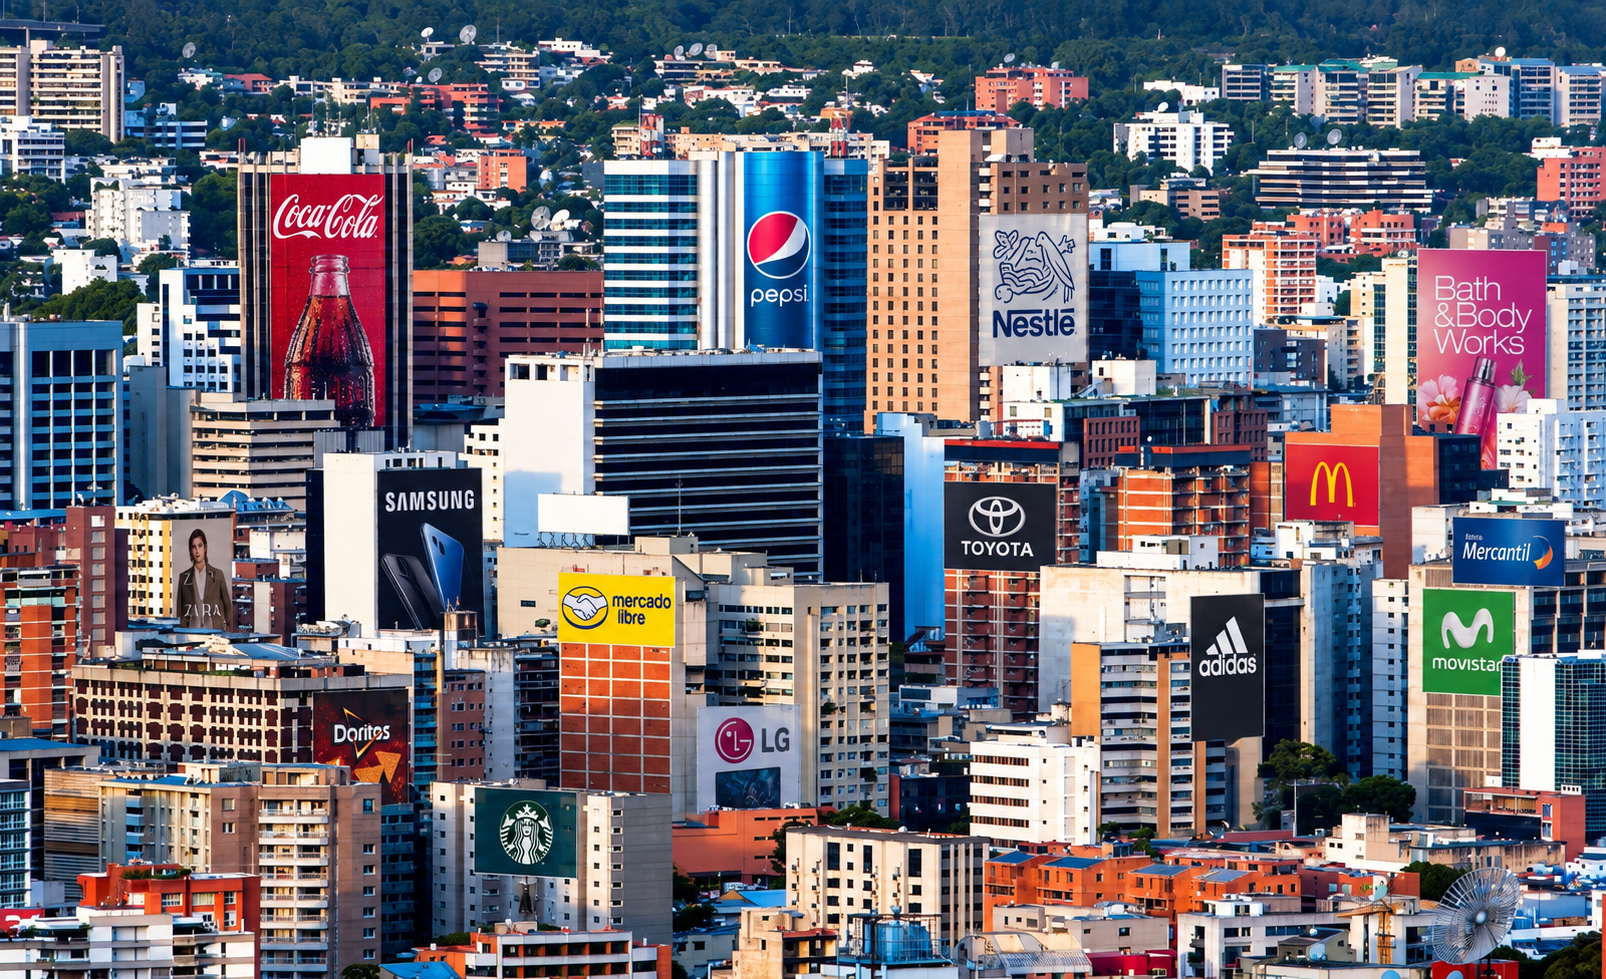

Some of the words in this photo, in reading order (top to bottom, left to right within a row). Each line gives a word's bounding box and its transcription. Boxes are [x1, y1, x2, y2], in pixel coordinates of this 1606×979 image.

[272, 193, 384, 239] Coca-Cola
[750, 283, 808, 307] pepsi
[1435, 275, 1501, 301] Bath
[992, 308, 1076, 338] Nestlé
[1434, 302, 1532, 334] &Body
[1433, 328, 1525, 355] Works
[385, 489, 475, 513] SAMSUNG
[961, 540, 1034, 557] TOYOTA
[1462, 541, 1531, 562] Mercantil
[612, 593, 672, 609] mercado
[617, 608, 646, 625] libre
[1198, 653, 1257, 677] adidas
[1432, 657, 1502, 672] movistar
[334, 723, 391, 743] Doritos
[761, 726, 790, 753] LG
